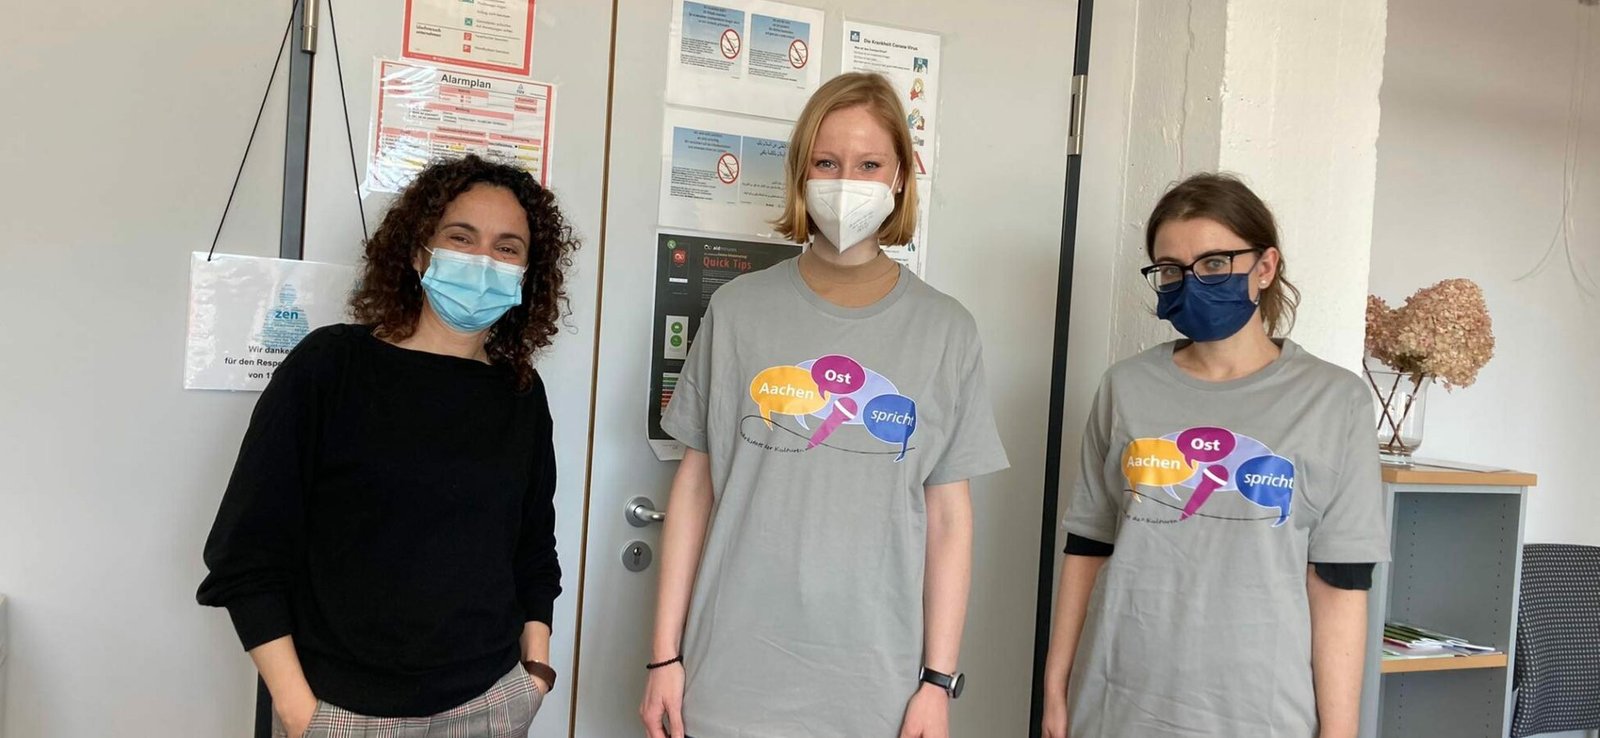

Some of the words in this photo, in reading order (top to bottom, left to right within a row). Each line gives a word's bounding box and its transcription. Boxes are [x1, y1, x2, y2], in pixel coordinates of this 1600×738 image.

[441, 74, 491, 88] Alarmplan
[704, 256, 730, 269] Quick
[732, 259, 752, 272] Tips
[274, 310, 299, 320] zen
[248, 345, 262, 353] Wir
[225, 357, 236, 365] für
[238, 358, 255, 366] den
[824, 369, 852, 385] Ost
[759, 382, 815, 400] Aachen
[870, 409, 914, 427] spricht
[1190, 437, 1221, 452] Ost
[1127, 455, 1181, 470] Aachen
[1243, 472, 1294, 490] spricht
